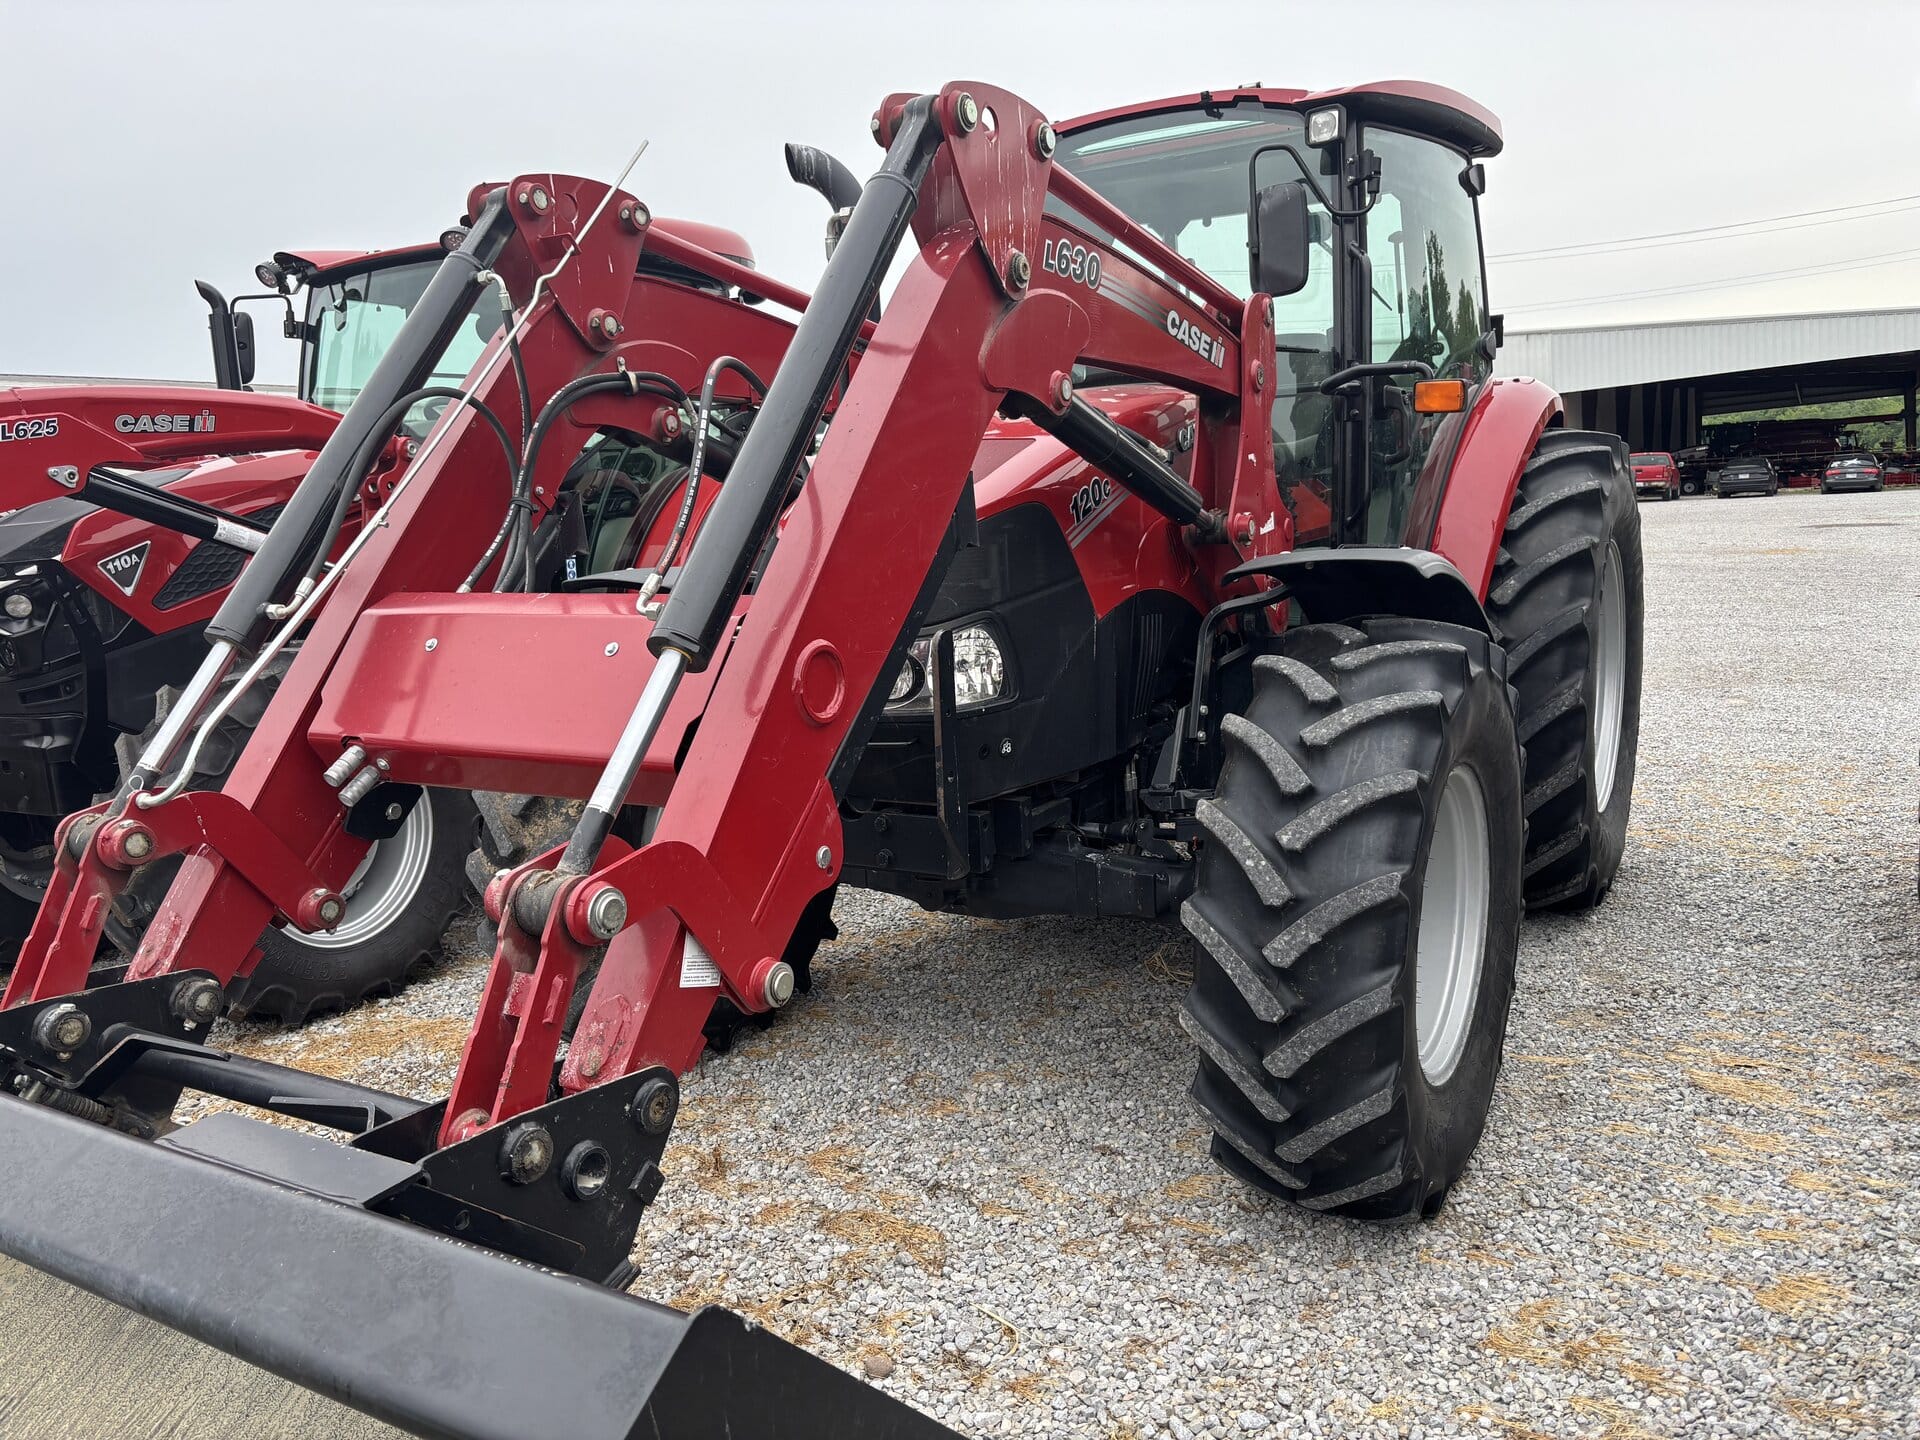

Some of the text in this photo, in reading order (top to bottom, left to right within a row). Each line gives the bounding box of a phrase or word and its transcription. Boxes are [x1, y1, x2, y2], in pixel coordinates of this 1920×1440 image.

[1043, 238, 1101, 289] L630
[1166, 310, 1211, 359] CASE
[0, 417, 59, 442] L625
[114, 413, 190, 433] CASE
[106, 553, 141, 574] 110A
